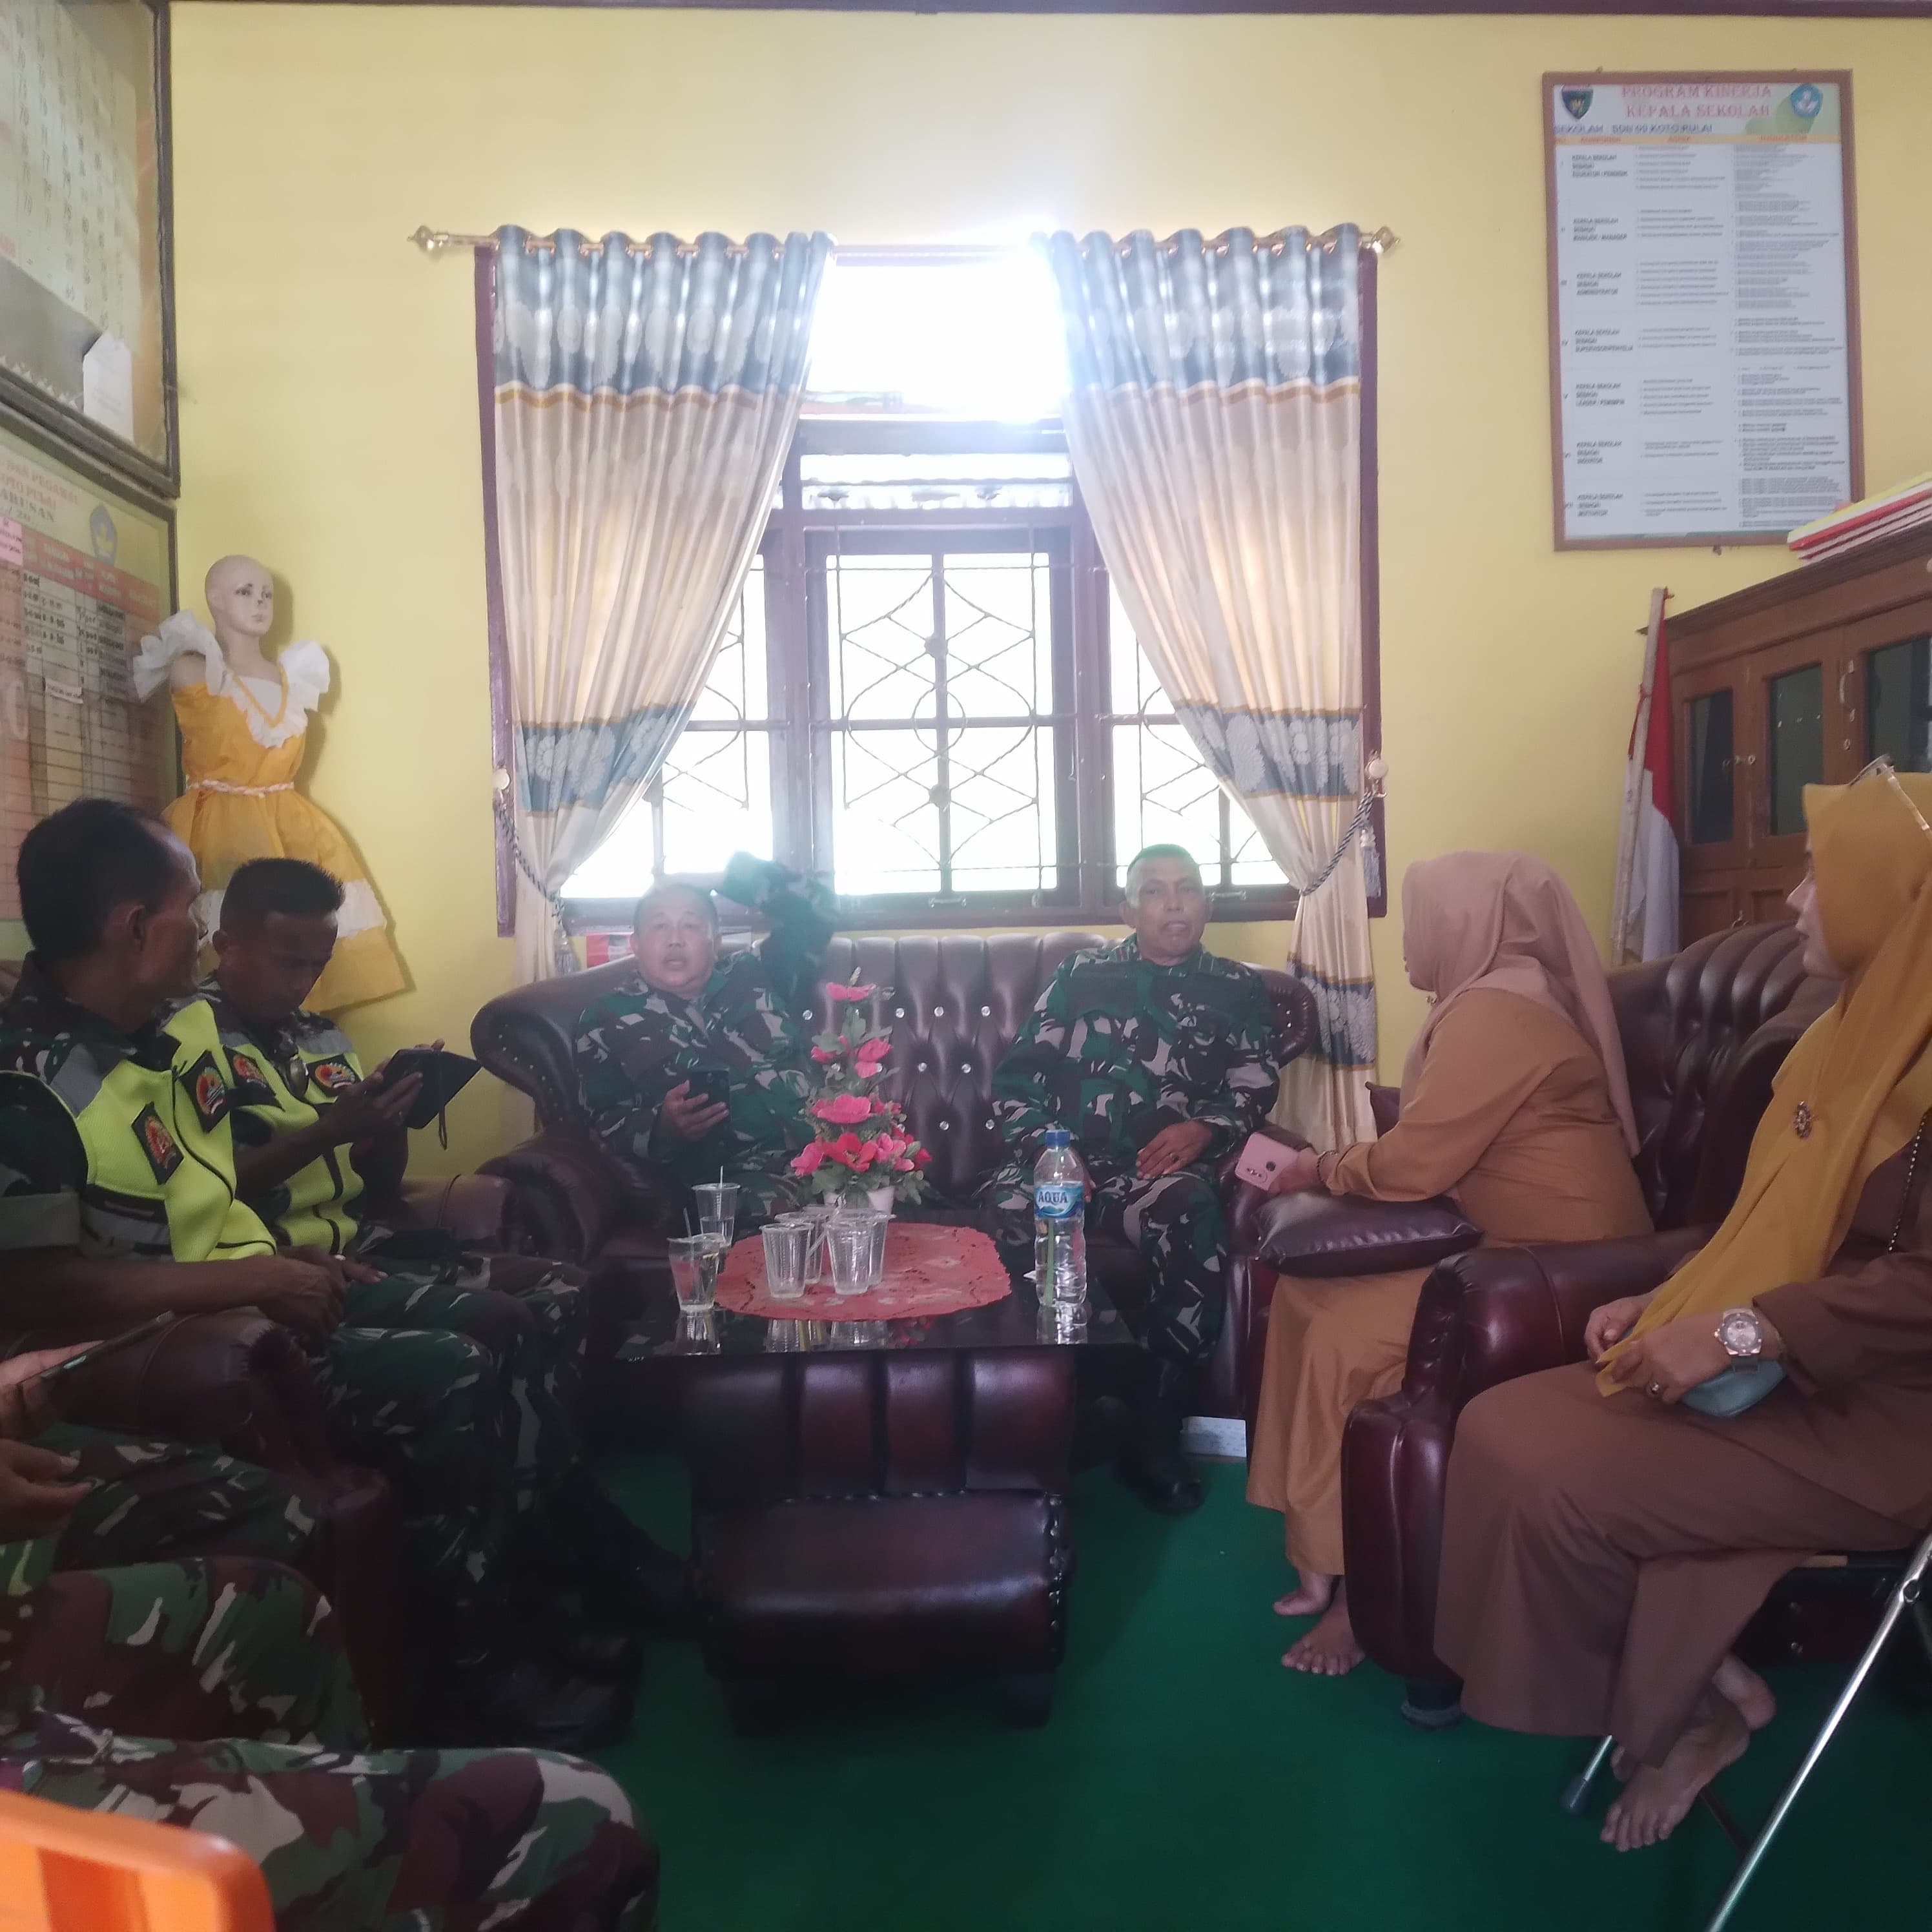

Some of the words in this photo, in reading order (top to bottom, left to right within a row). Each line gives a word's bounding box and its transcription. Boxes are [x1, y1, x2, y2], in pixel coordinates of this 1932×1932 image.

[1621, 85, 1700, 98] PROGRAM
[1704, 84, 1772, 98] KINERJA
[1627, 104, 1691, 118] KEPALA
[1696, 103, 1770, 117] SEKOLAH
[1038, 1191, 1067, 1206] AQUA
